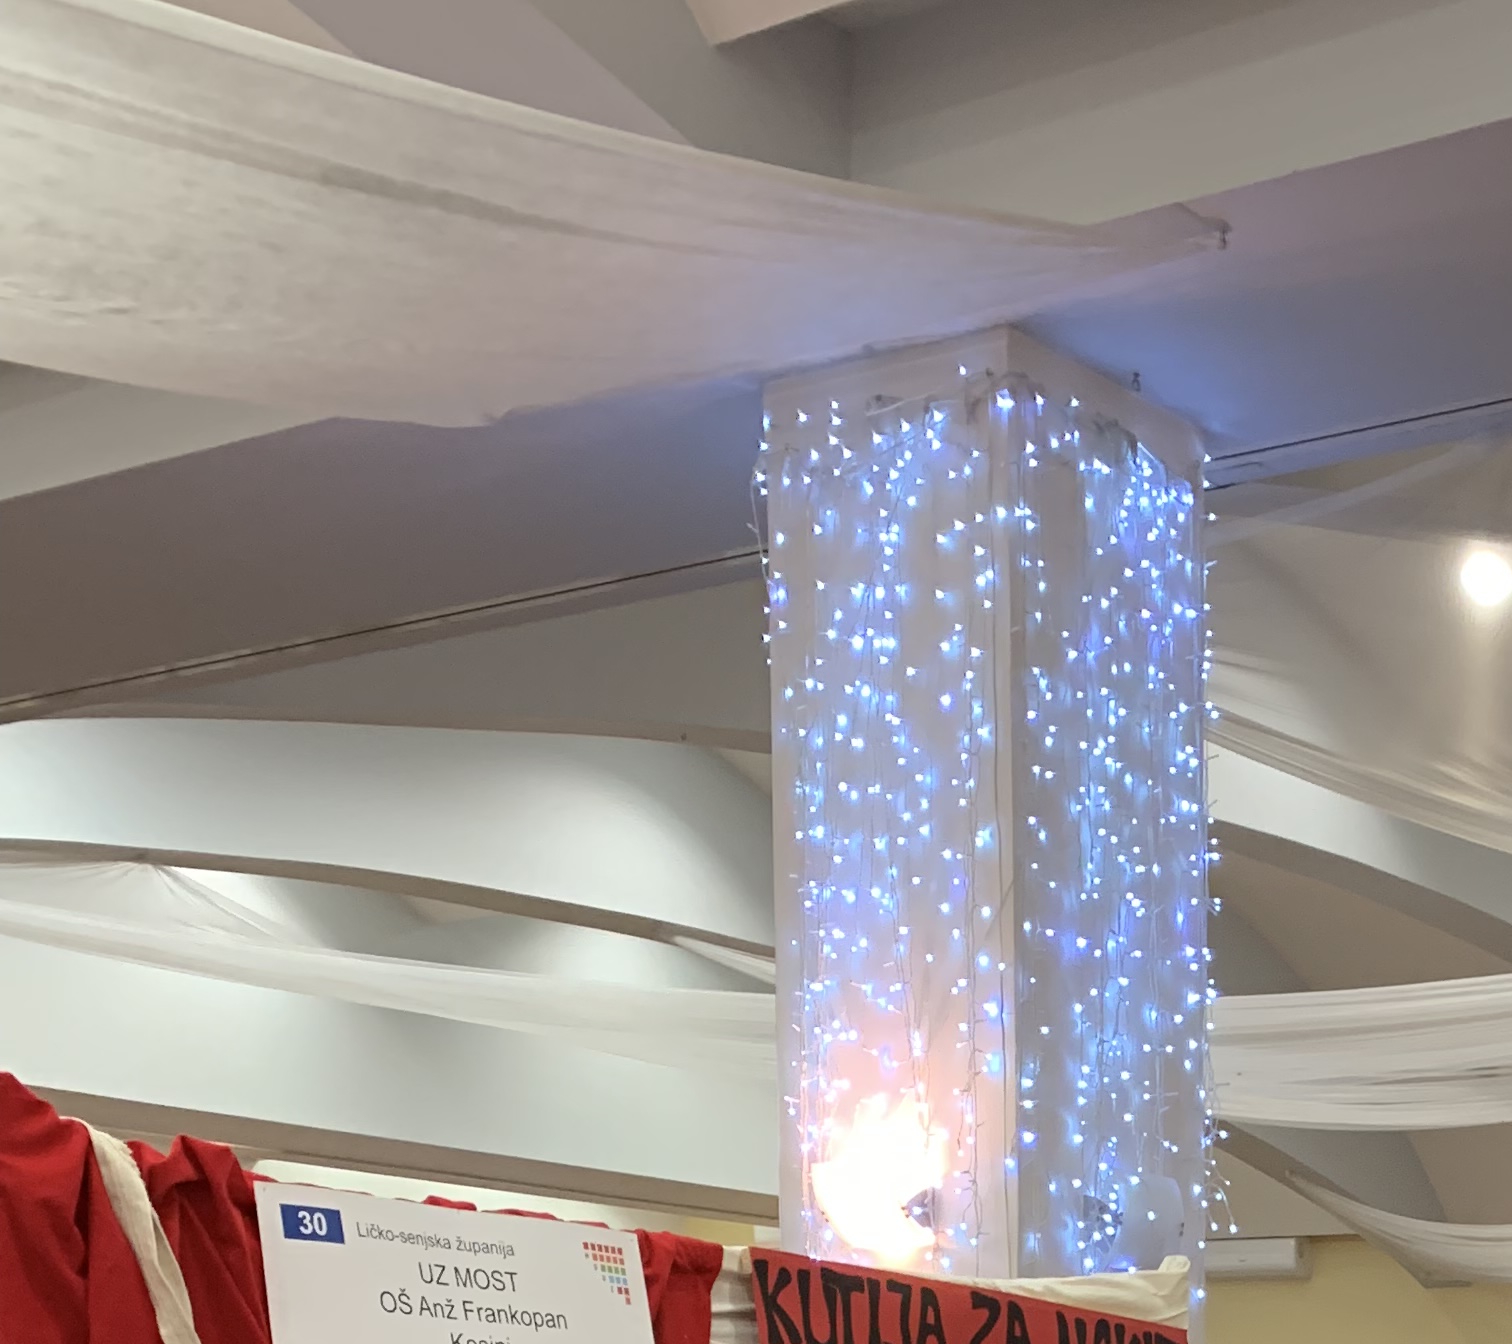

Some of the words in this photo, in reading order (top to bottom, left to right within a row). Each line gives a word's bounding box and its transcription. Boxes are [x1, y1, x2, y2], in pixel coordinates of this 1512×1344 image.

[298, 1211, 328, 1236] 30
[356, 1222, 451, 1250] Ličko-senjska
[455, 1236, 515, 1259] županija
[418, 1262, 450, 1286] UZ
[453, 1266, 518, 1292] MOST
[379, 1288, 413, 1315] OŠ
[418, 1296, 458, 1320] Anž
[461, 1300, 568, 1331] Frankopan
